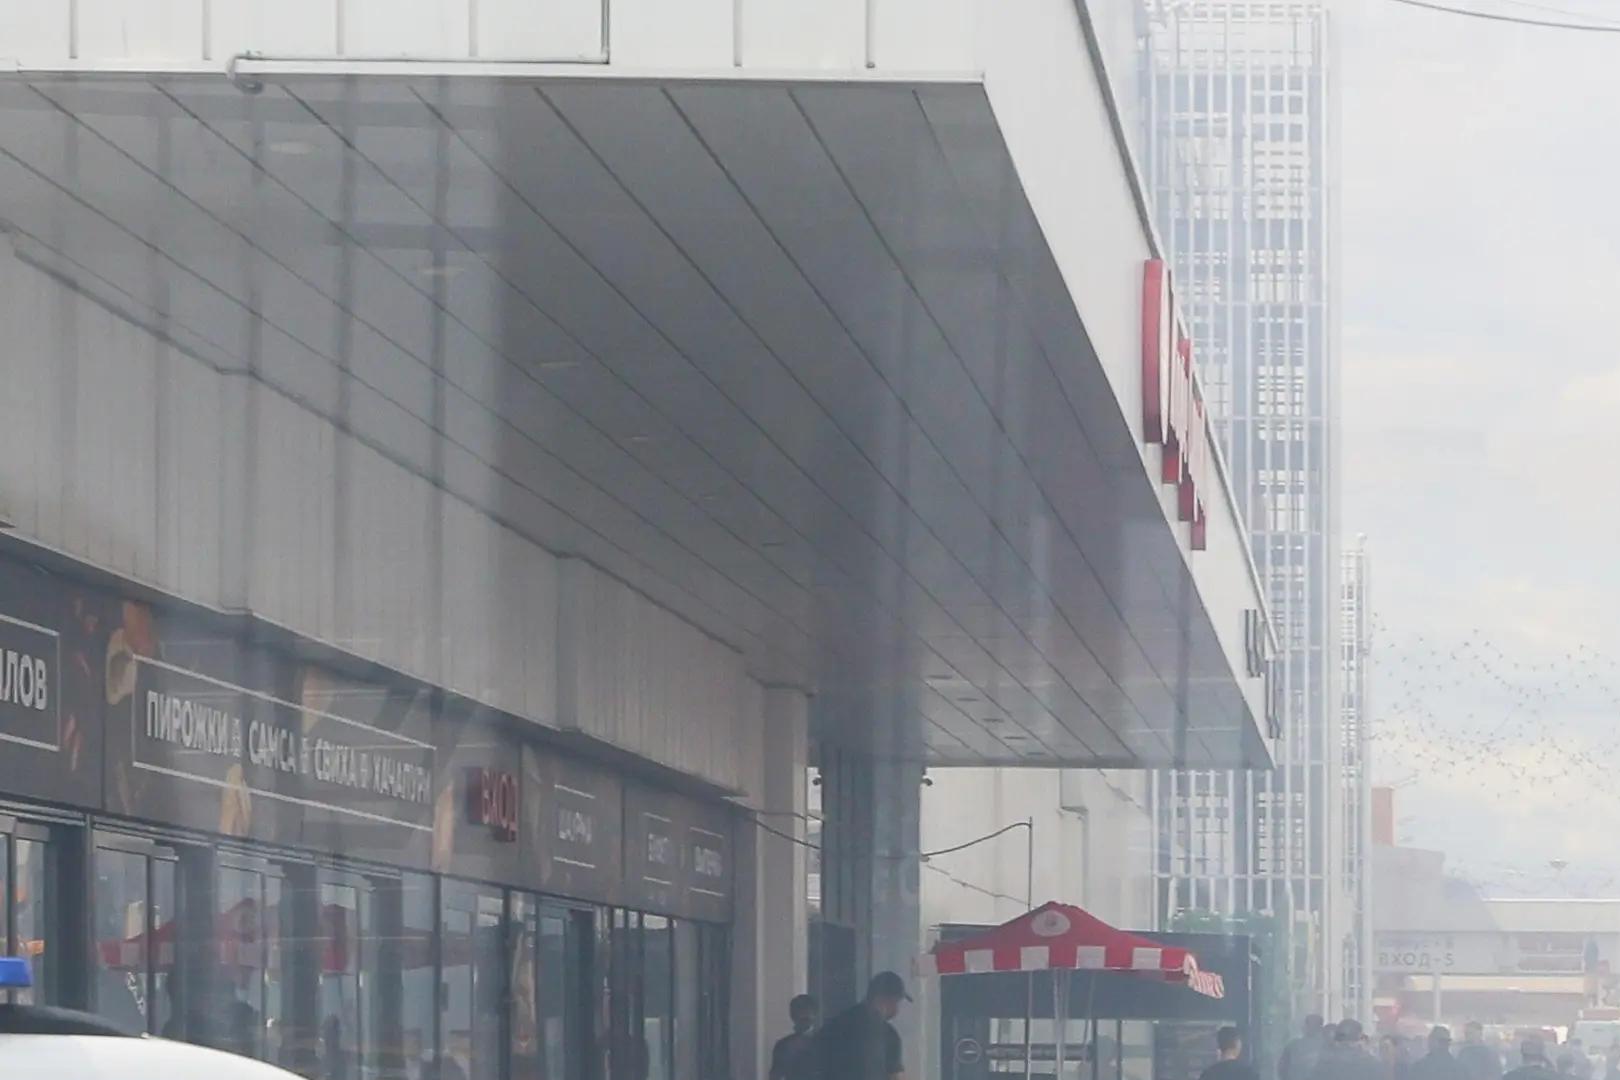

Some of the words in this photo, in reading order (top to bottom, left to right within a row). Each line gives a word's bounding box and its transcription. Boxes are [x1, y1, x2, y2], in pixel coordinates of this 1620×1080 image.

[0, 649, 47, 710] ЛОВ
[147, 690, 228, 756] ПИРОЖКИ
[249, 719, 297, 774] САМСА
[481, 768, 519, 843] ВХОД
